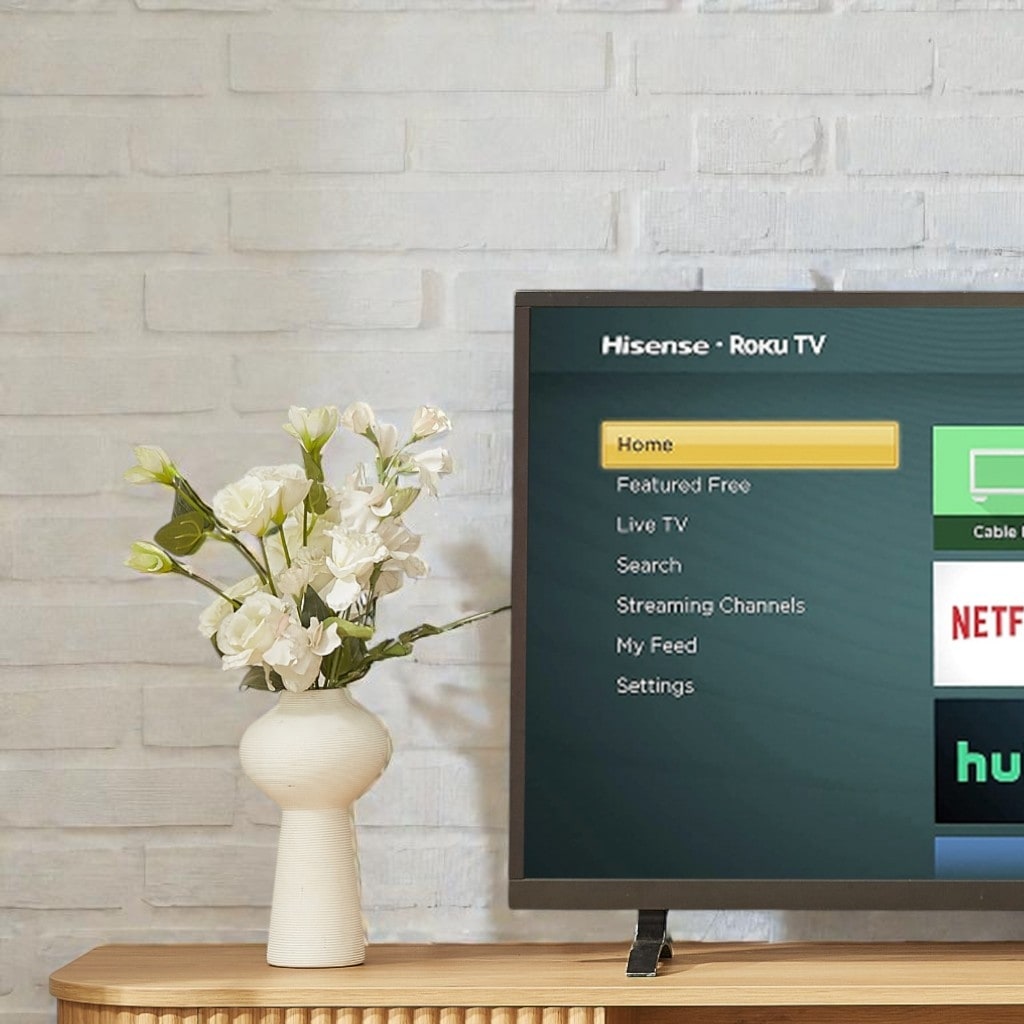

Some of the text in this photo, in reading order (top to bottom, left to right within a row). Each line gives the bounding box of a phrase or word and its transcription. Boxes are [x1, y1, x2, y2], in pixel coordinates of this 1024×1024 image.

[601, 335, 827, 355] Hisense Roku TV
[617, 436, 674, 452] Home
[616, 476, 751, 494] Featured Free
[616, 516, 689, 533] Live TV
[973, 525, 1022, 540] Cable
[616, 556, 682, 574] Search
[616, 596, 806, 616] Streaming Channels
[616, 636, 698, 656] My Feed
[616, 676, 695, 698] Settings
